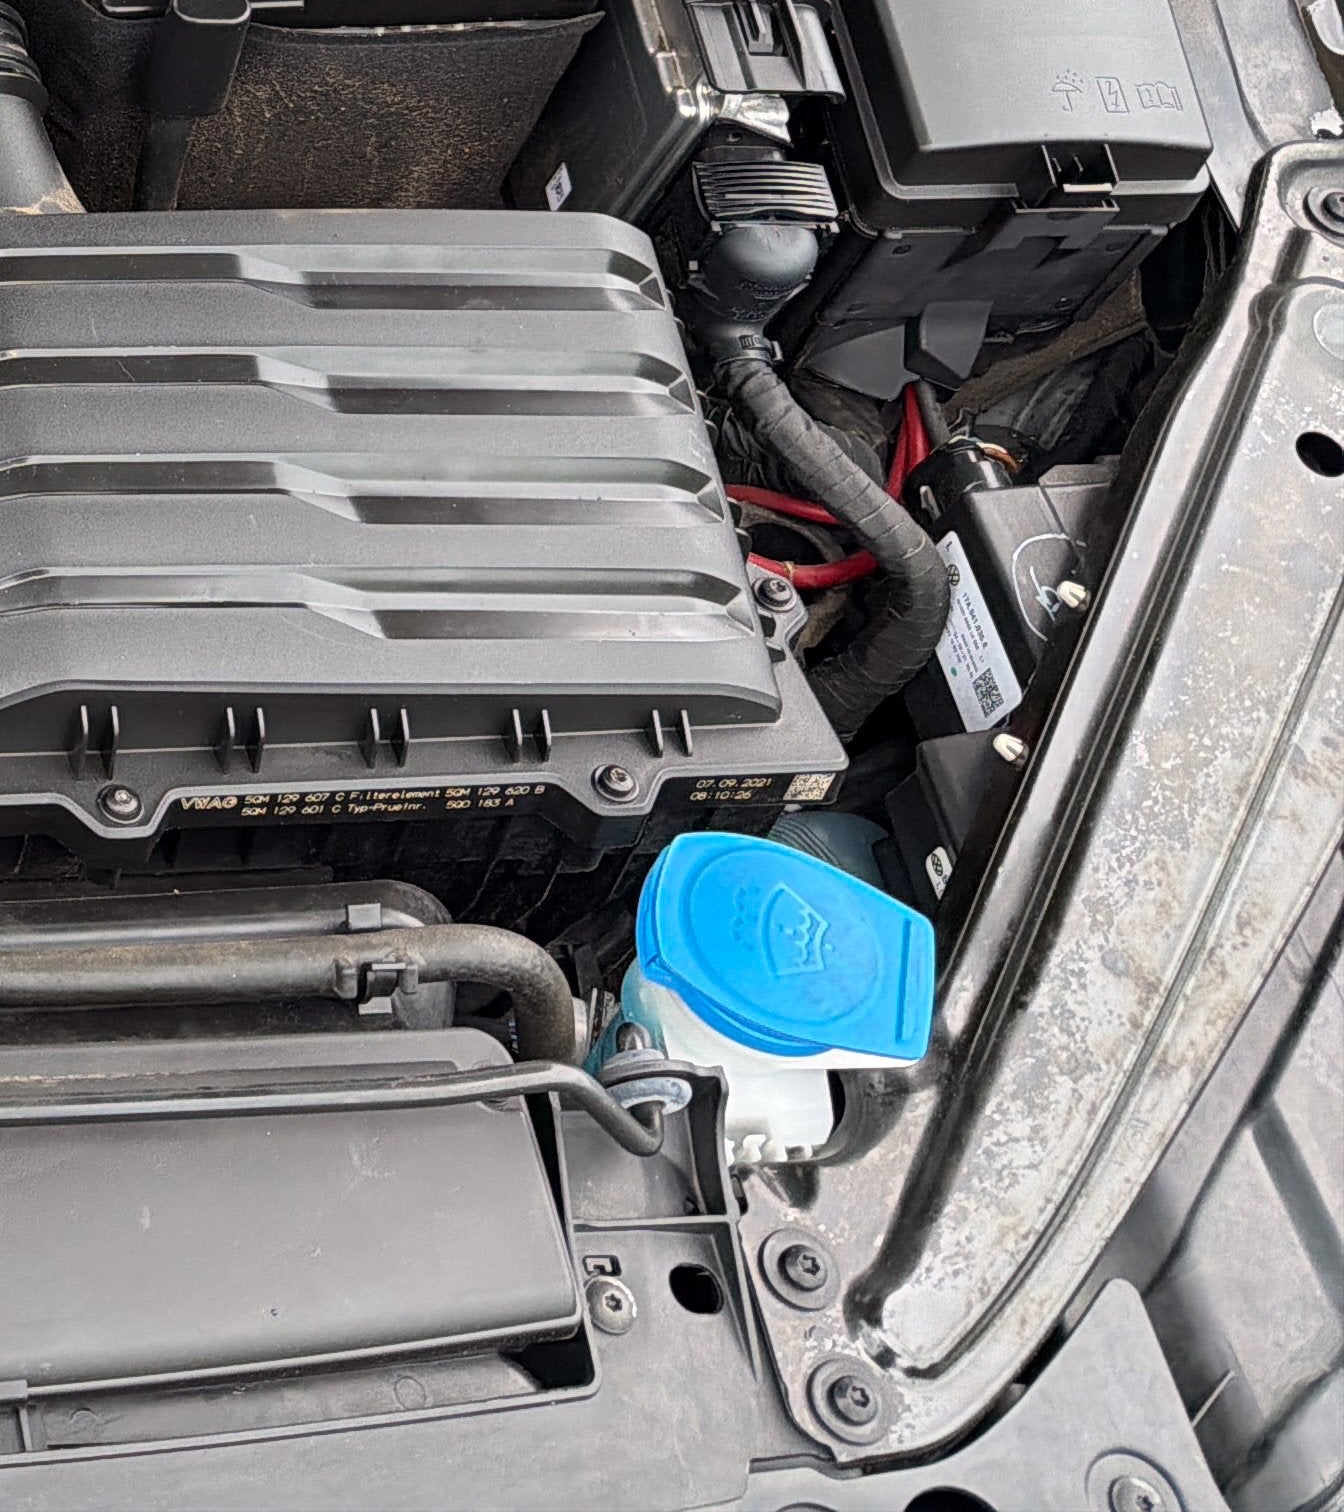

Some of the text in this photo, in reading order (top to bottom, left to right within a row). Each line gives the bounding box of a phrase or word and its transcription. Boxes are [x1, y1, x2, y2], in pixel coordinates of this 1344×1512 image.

[695, 777, 773, 789] 07.09.2021
[180, 785, 545, 810] VWAG 5QM 129 607 C Filterelement 5QM 129 620 B
[689, 790, 753, 801] 08:10:26
[241, 806, 266, 816] 5QM
[274, 805, 297, 815] 129
[301, 804, 325, 814] 601
[332, 804, 342, 814] C
[478, 798, 501, 808] 183
[504, 798, 515, 807] A
